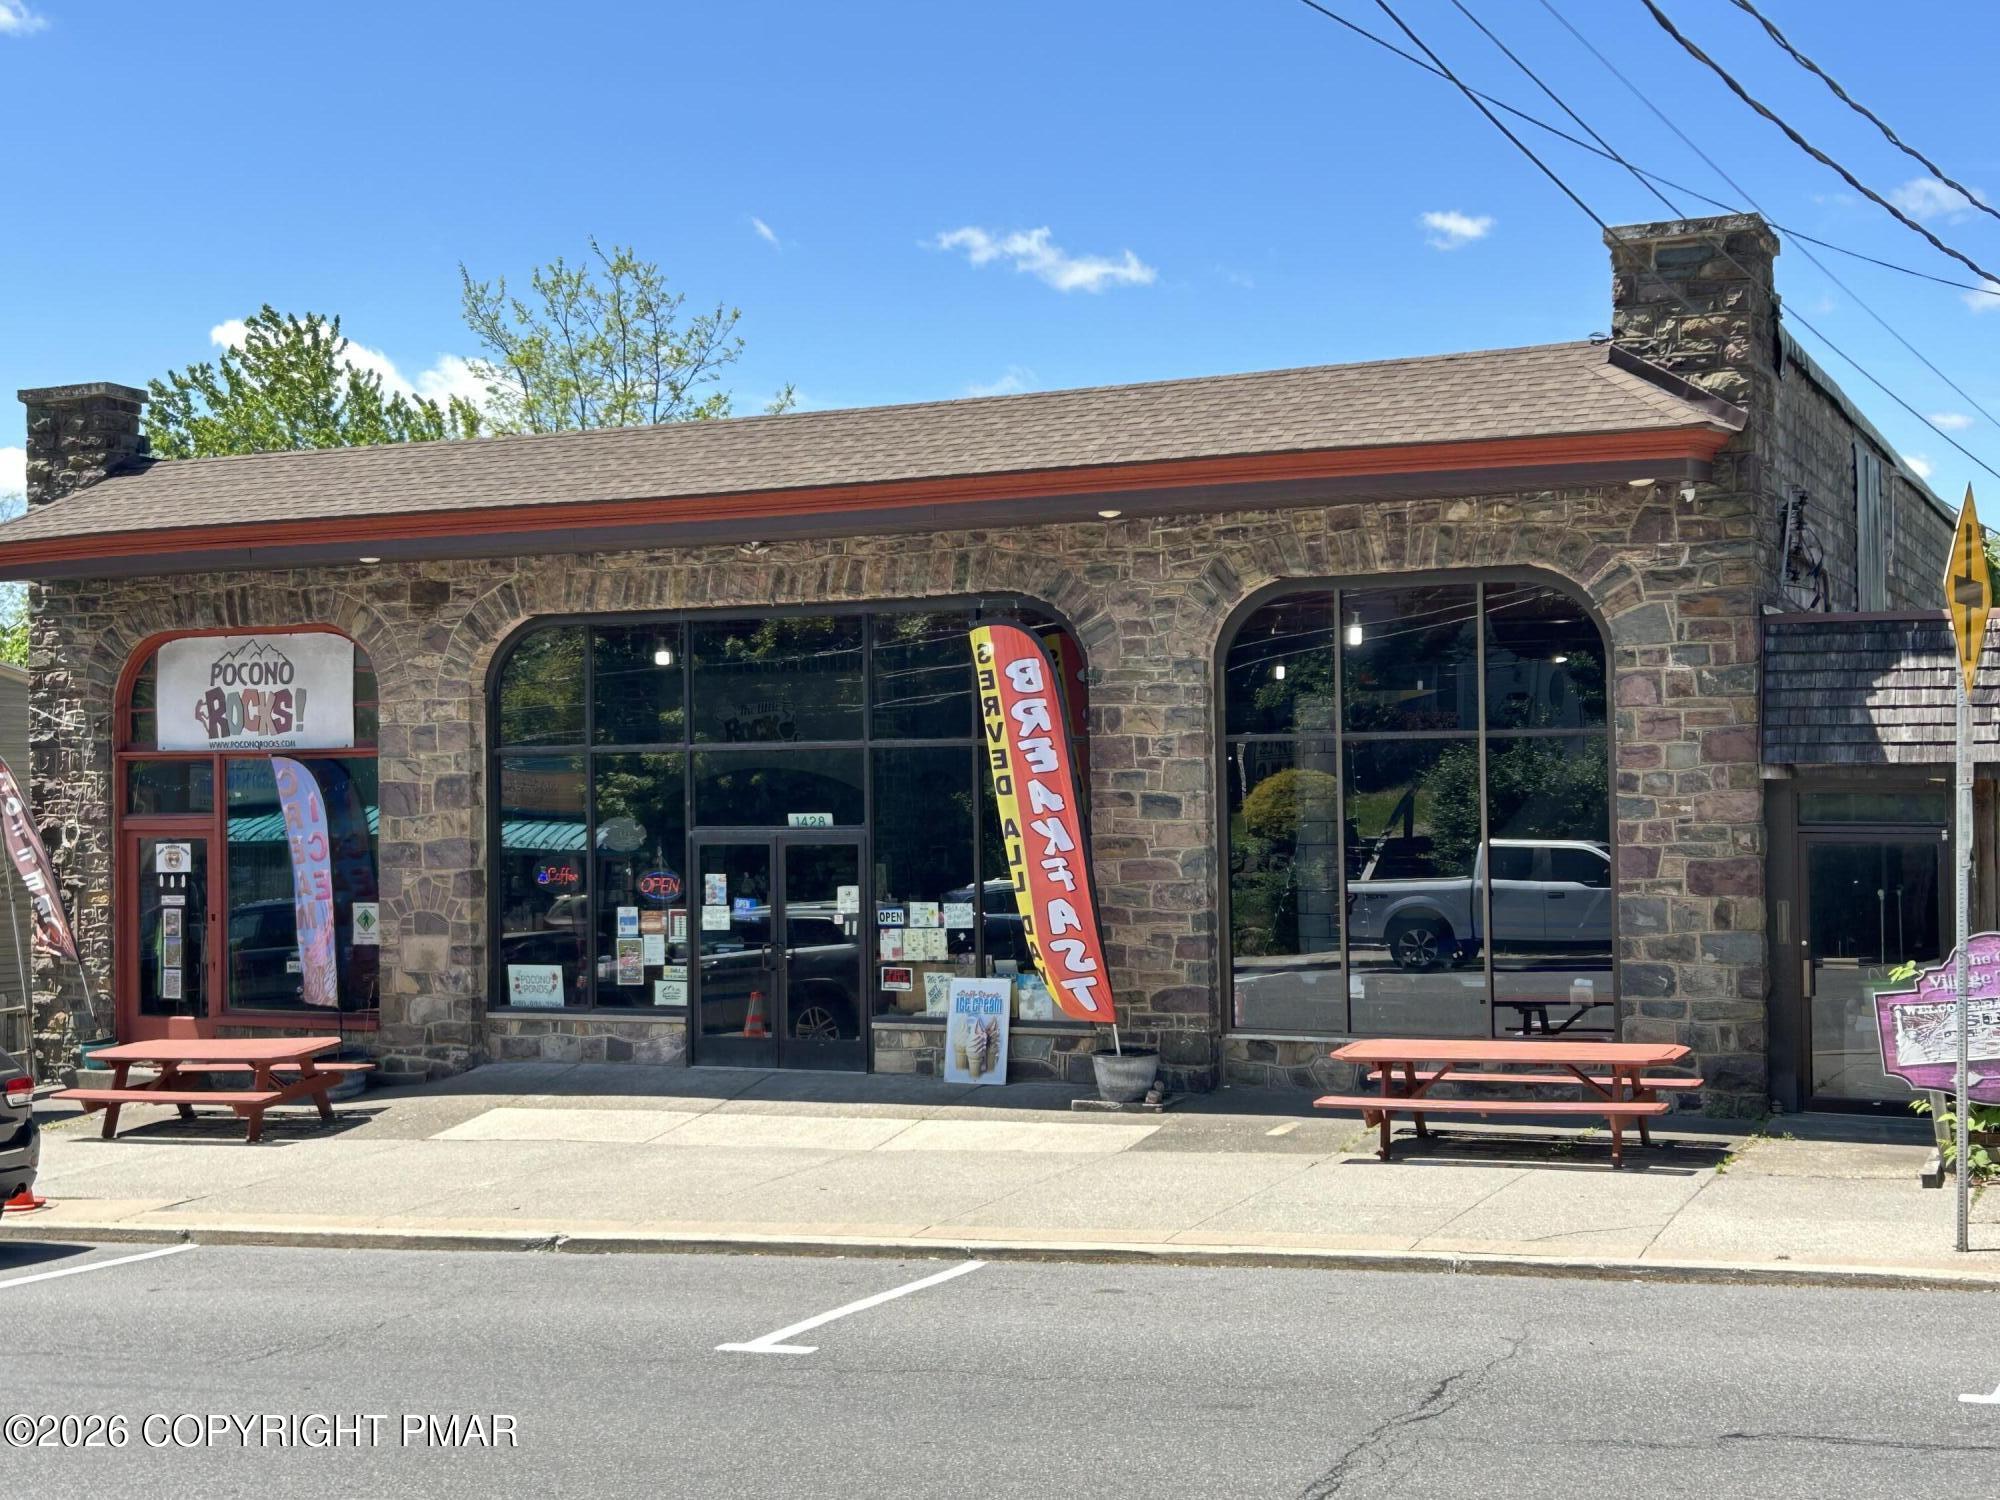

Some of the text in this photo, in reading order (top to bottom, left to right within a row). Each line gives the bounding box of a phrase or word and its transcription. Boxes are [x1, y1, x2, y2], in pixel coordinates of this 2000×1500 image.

[210, 661, 295, 686] POCONO
[205, 687, 307, 739] ROCKS!
[796, 816, 826, 827] 1428
[640, 877, 680, 894] OPEN
[880, 912, 902, 922] OPEN
[1928, 971, 1992, 989] Villge
